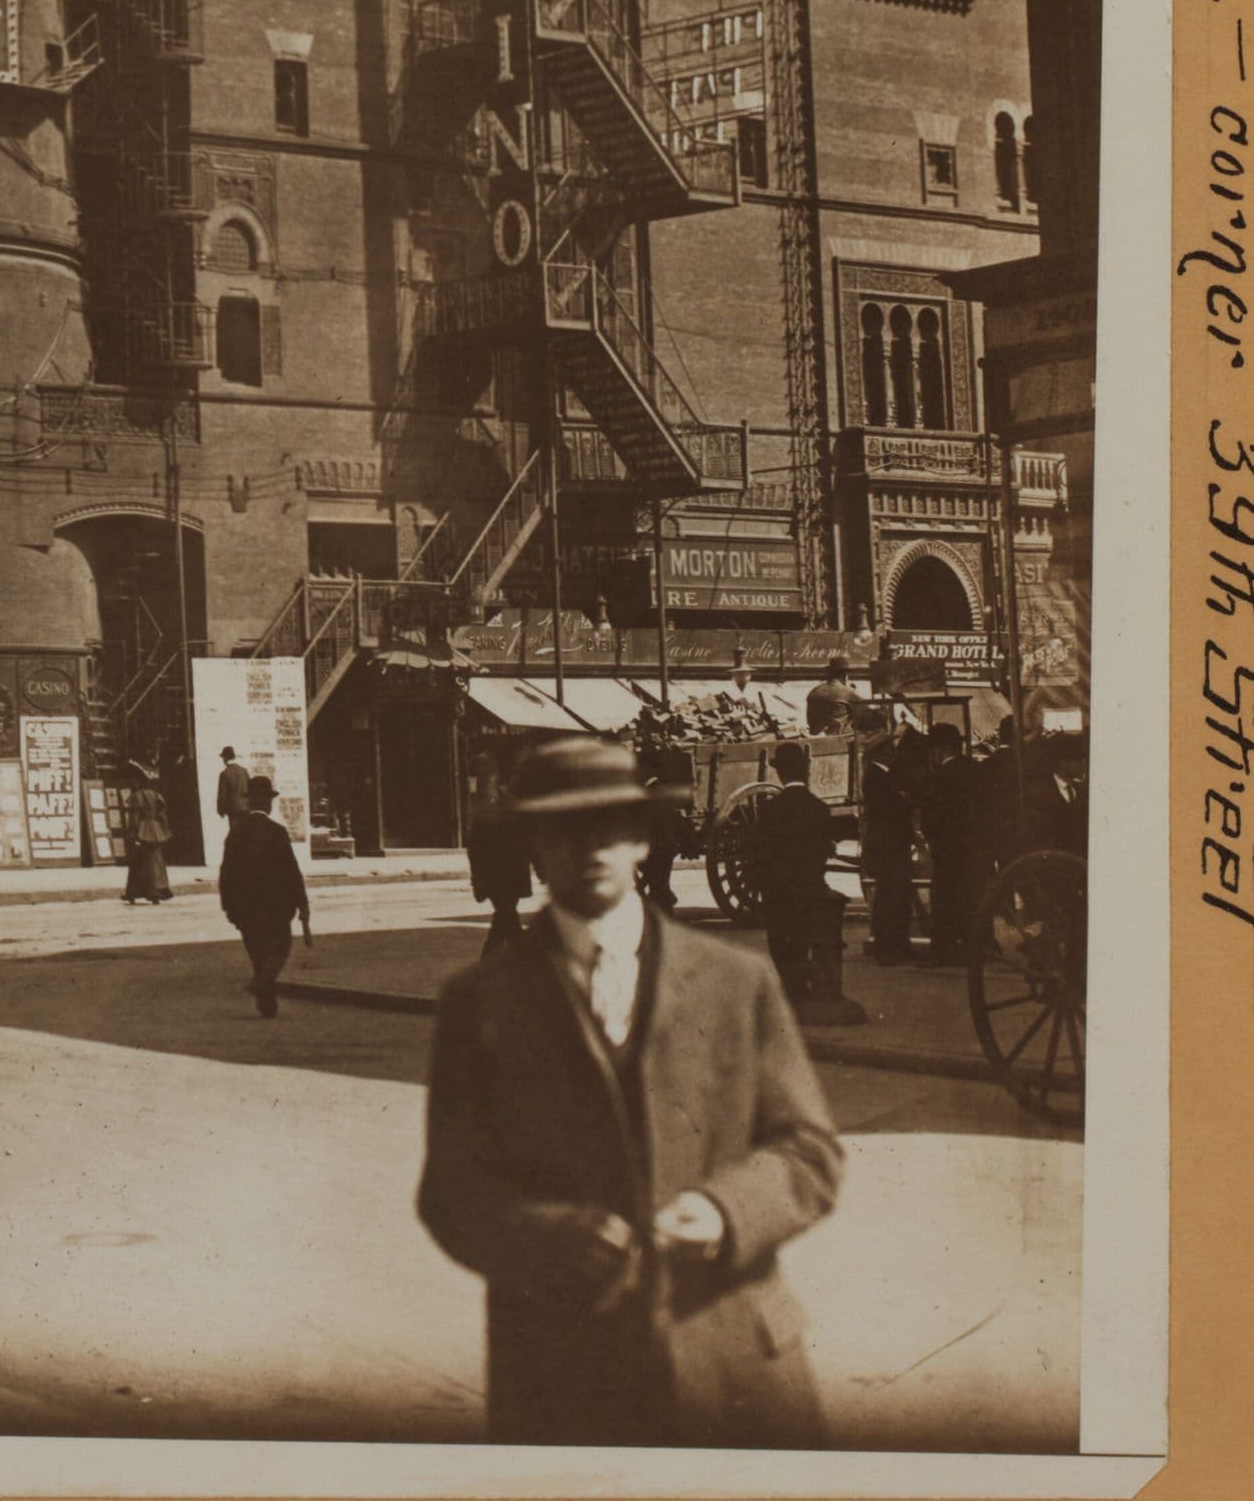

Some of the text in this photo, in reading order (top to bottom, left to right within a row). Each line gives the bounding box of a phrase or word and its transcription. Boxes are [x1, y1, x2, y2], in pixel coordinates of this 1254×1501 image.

[1177, 106, 1248, 368] corner
[670, 547, 758, 578] MORTON
[719, 592, 790, 607] ANTIQUE
[27, 679, 71, 697] CASINO
